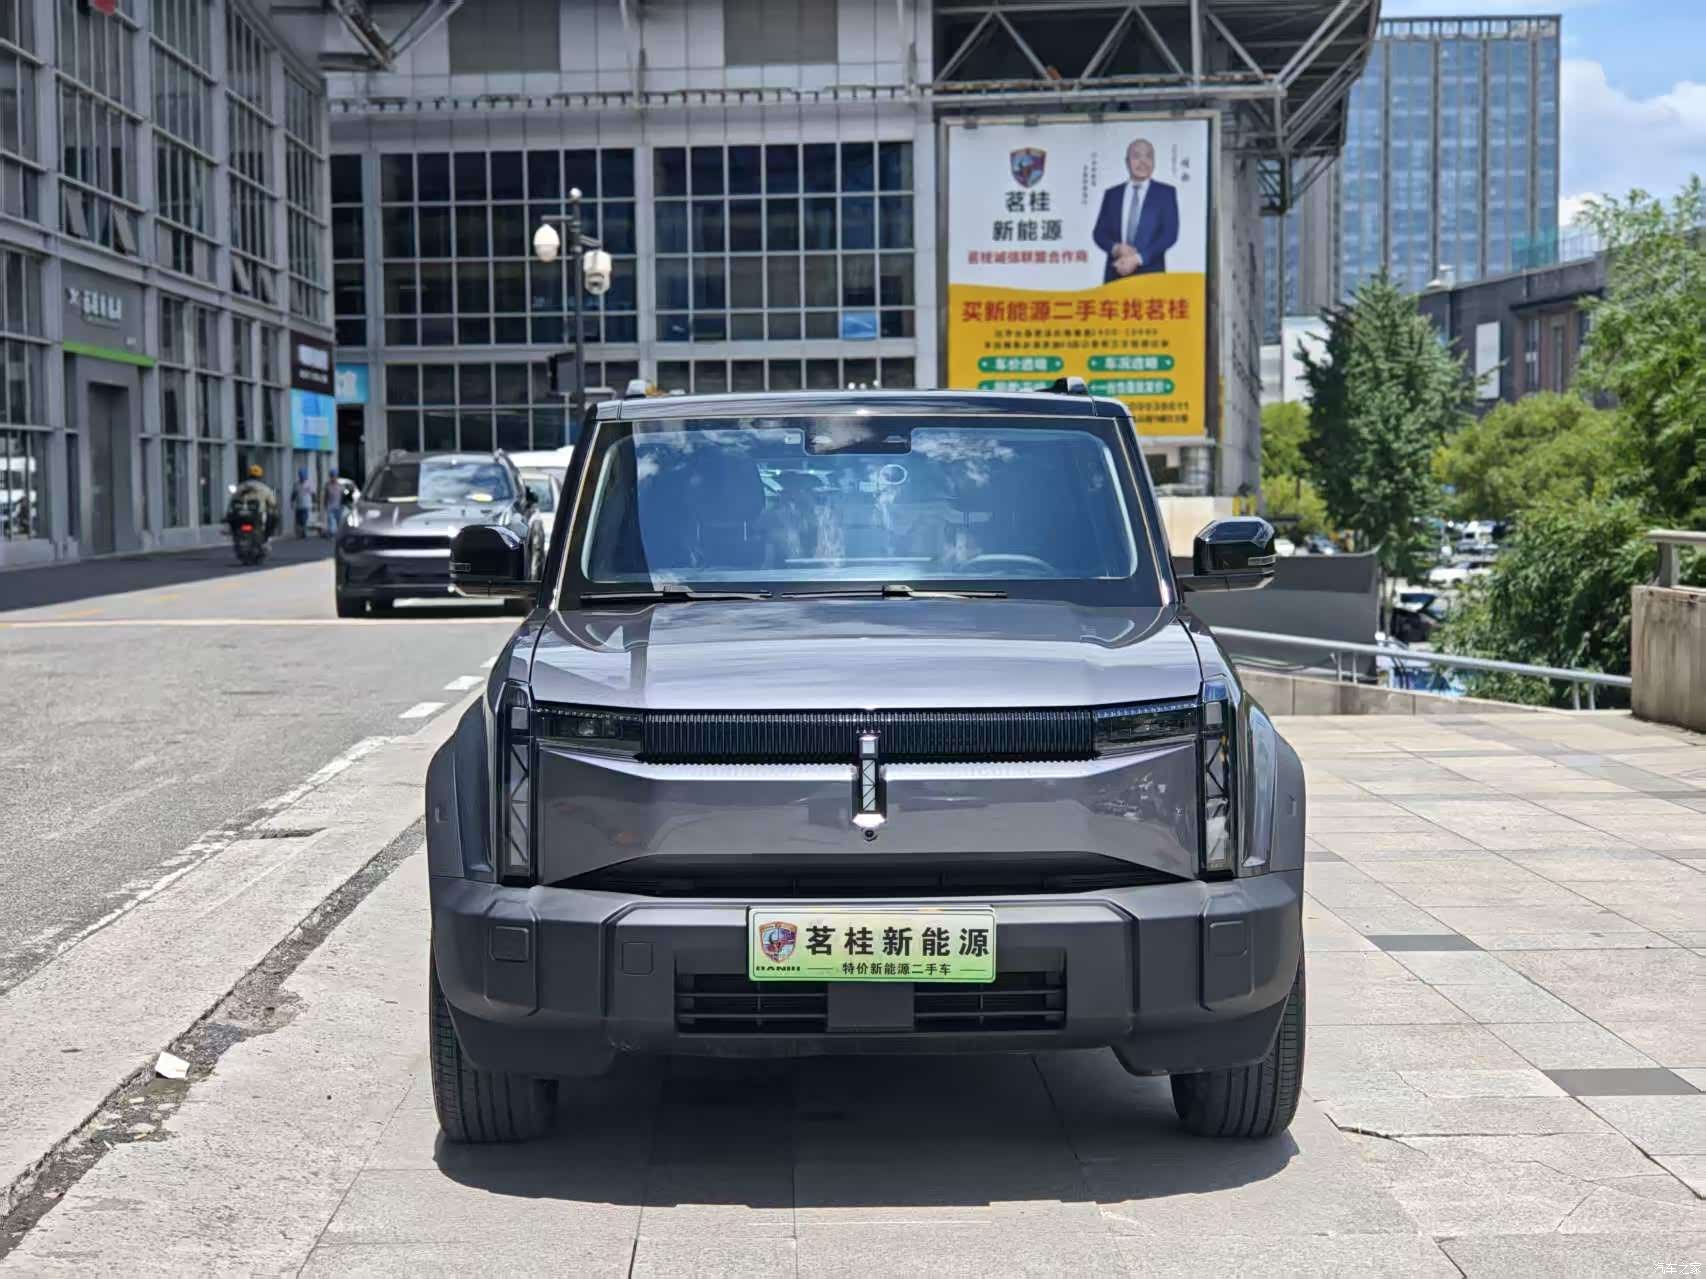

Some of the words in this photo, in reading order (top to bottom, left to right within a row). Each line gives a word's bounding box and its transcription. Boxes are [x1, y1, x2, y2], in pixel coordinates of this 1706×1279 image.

[1005, 191, 1051, 213] 茗桂
[992, 219, 1064, 242] 新能源
[962, 298, 1190, 322] 买新能源二手车找茗桂
[805, 926, 990, 957] 茗桂新能源
[842, 962, 951, 976] 特价新能源二手车
